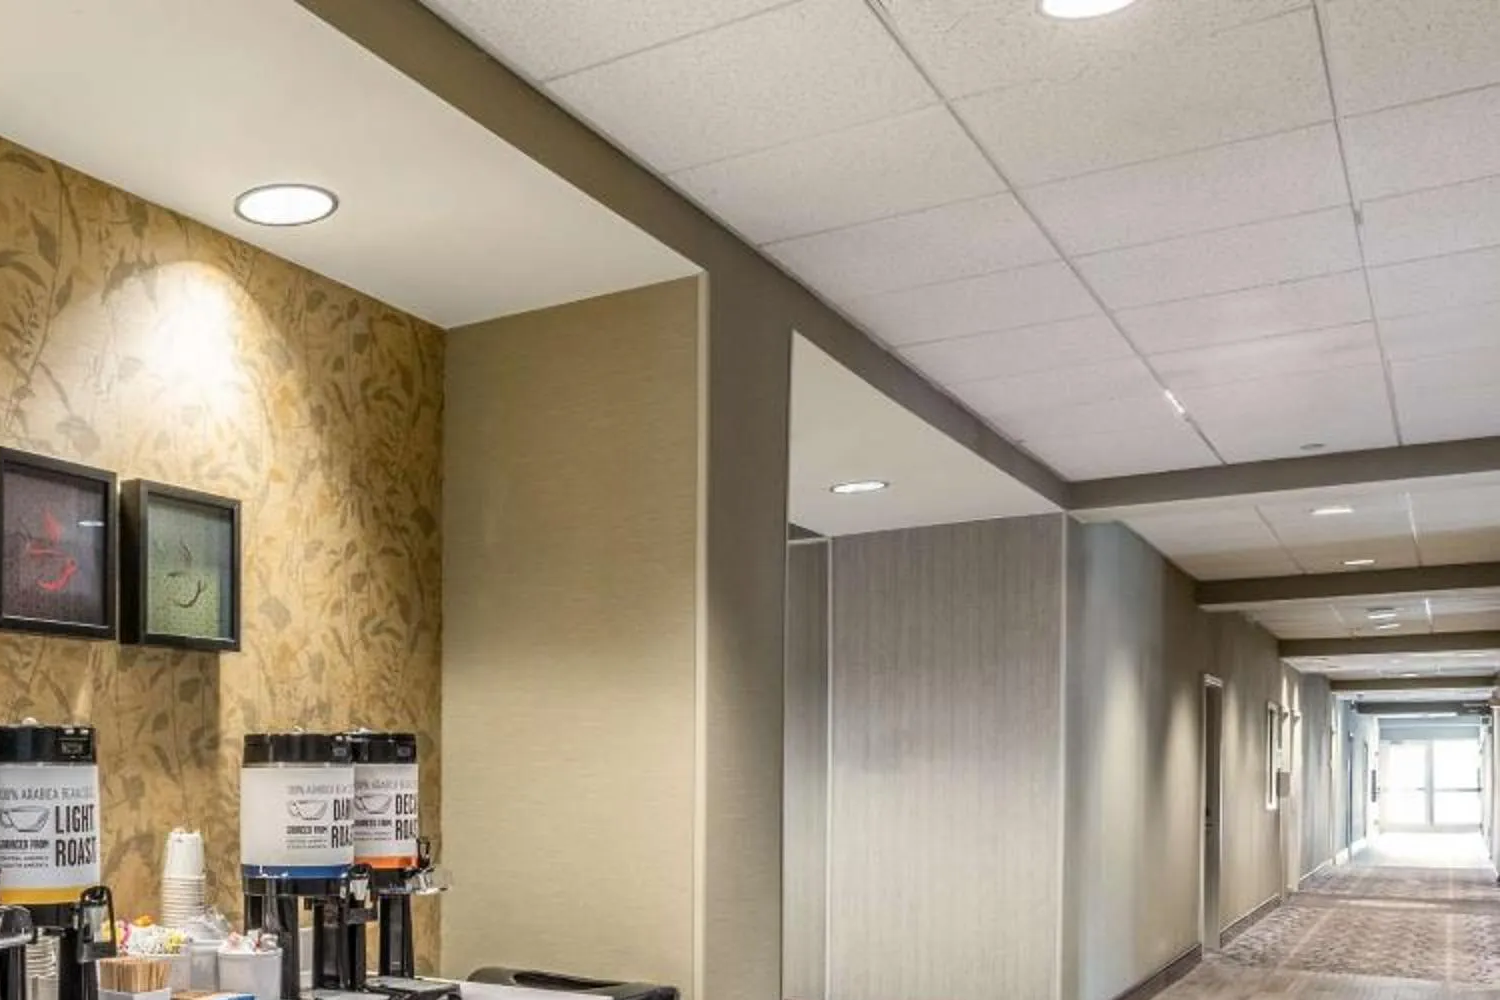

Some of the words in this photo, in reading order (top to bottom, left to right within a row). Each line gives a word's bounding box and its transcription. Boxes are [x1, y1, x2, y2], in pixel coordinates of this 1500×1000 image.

[333, 797, 351, 821] DAR
[395, 793, 417, 815] DEC
[55, 803, 95, 834] LIGHT
[55, 836, 96, 867] ROAST
